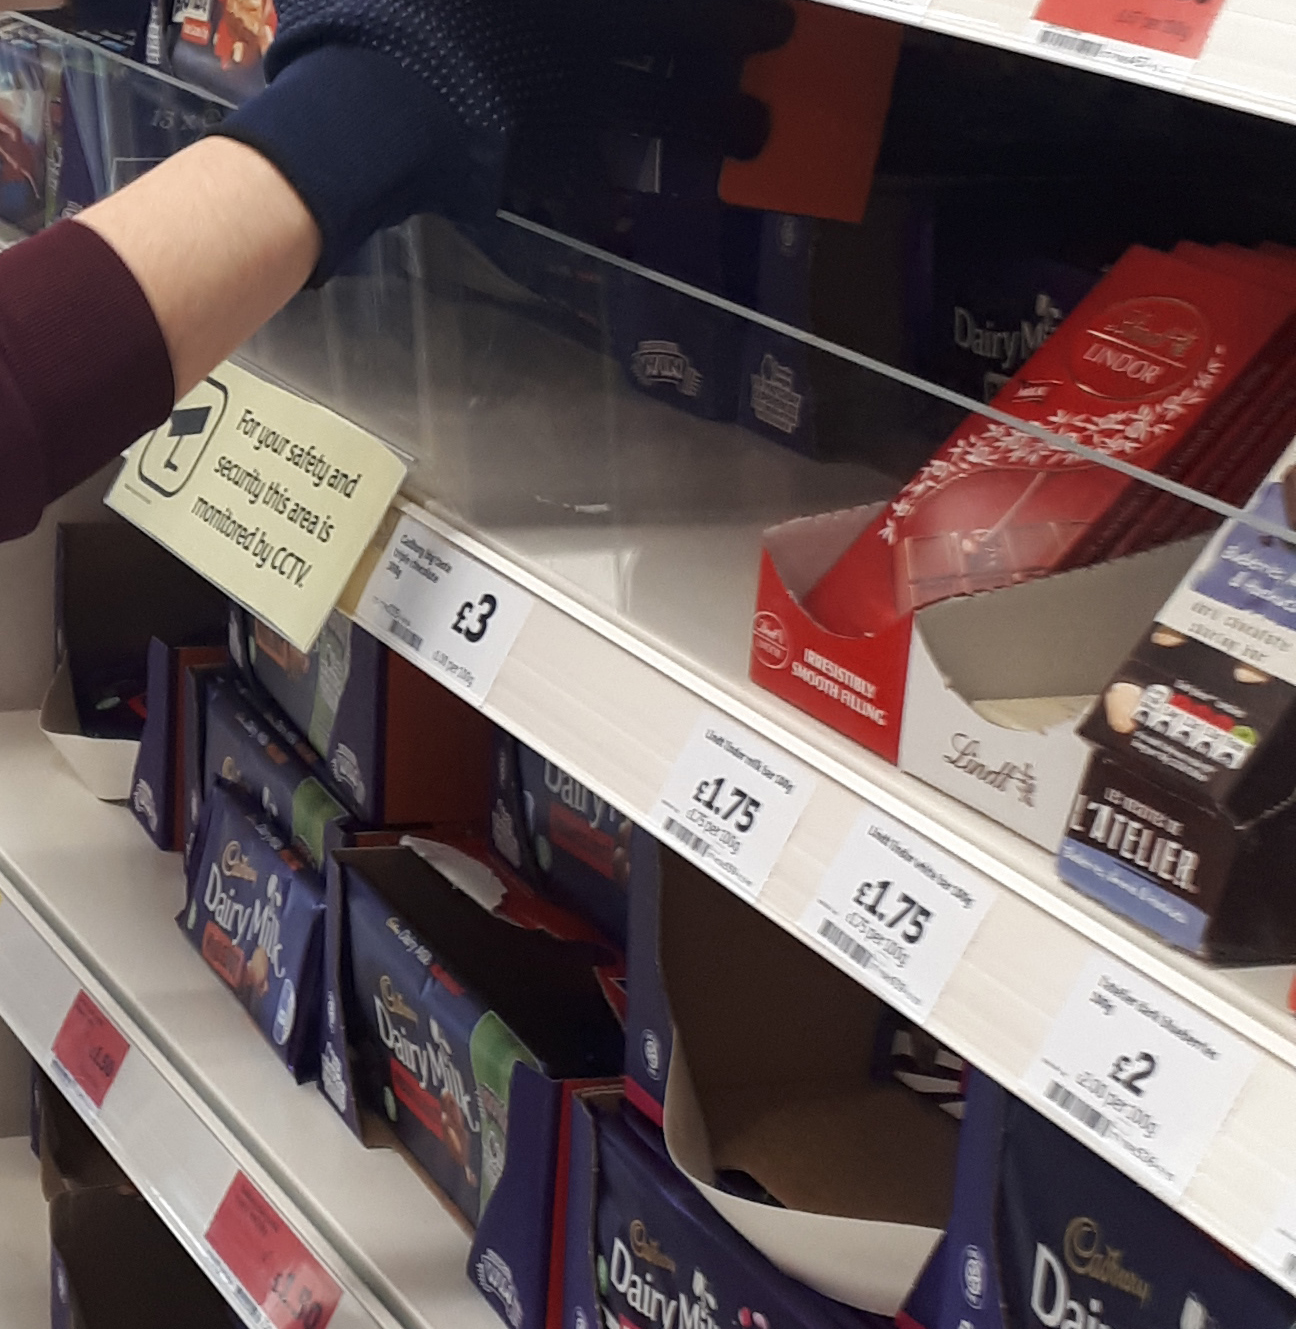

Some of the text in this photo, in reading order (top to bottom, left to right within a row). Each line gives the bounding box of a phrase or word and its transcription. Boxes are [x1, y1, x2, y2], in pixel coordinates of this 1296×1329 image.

[953, 306, 1020, 368] Dairy
[1081, 343, 1163, 387] LINDOR
[236, 408, 362, 499] For your safety and
[213, 454, 336, 544] security this area is
[190, 495, 313, 590] monitored by CCTV.
[450, 592, 498, 644] £3
[790, 660, 888, 727] SMOOTH FILLING
[803, 647, 877, 700] IRRESISTIBLY
[544, 758, 604, 830] Dairy
[942, 732, 1016, 792] Lindt
[692, 776, 761, 833] £1.75
[1070, 793, 1201, 894] L'ATELIER
[203, 861, 253, 946] Dairy
[246, 885, 287, 979] Milk
[851, 879, 933, 945] £1.75
[373, 993, 481, 1133] Dairy Milk
[1107, 1050, 1159, 1097] £2
[1064, 1216, 1152, 1308] Cadbury
